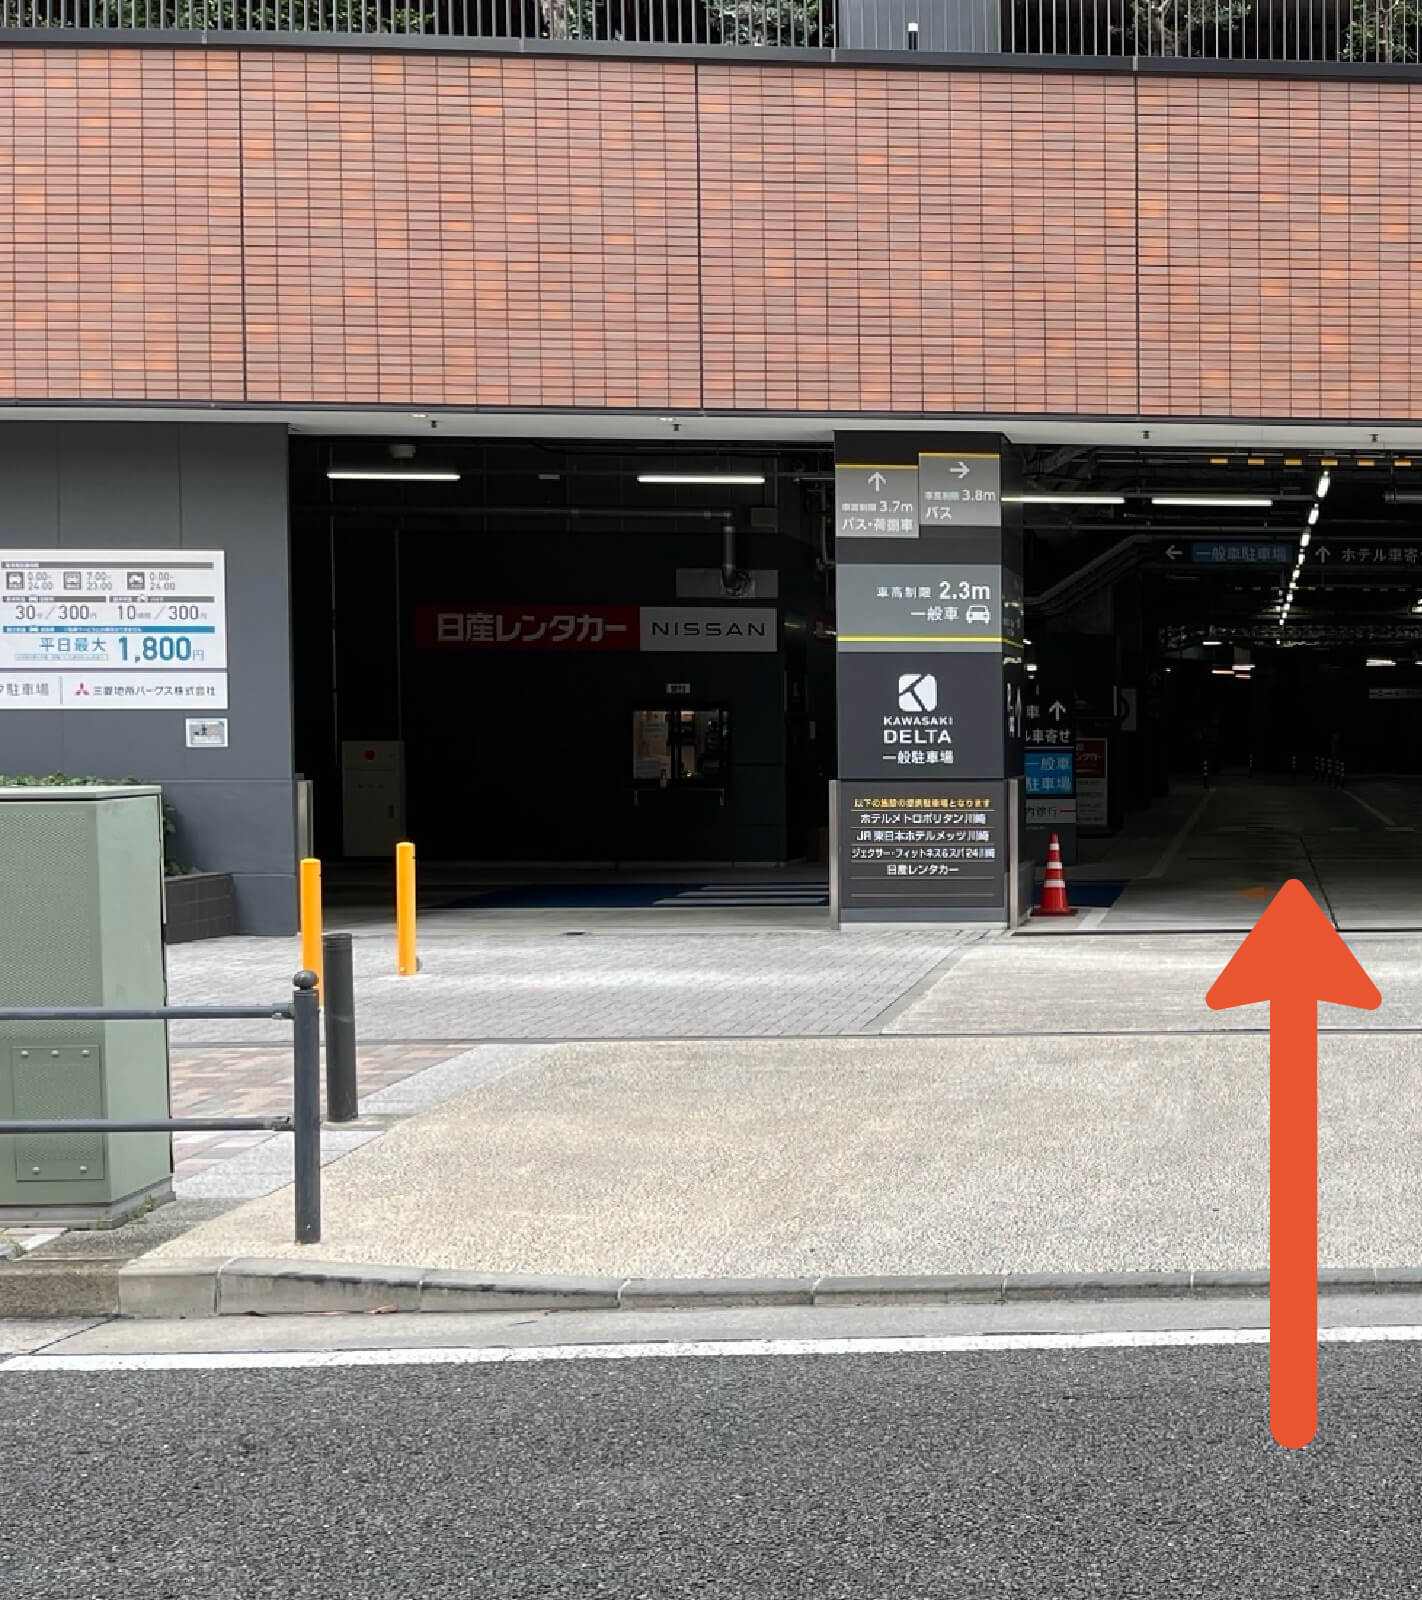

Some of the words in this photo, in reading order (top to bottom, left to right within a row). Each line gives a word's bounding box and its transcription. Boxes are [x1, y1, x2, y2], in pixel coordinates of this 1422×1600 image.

[962, 489, 996, 501] 3.8m
[879, 500, 913, 512] 3.7m
[925, 506, 952, 520] バス
[939, 581, 990, 600] 2.3m
[911, 606, 960, 621] 一般車
[437, 613, 627, 642] 日産レンタカー
[652, 622, 765, 636] NISSAN
[0, 683, 49, 697] 駐車場
[884, 716, 953, 726] KAWASAKI
[884, 730, 951, 744] DELTA
[882, 750, 954, 765] 一般駐車場
[1026, 776, 1072, 793] 駐車場
[860, 814, 987, 825] ホテルメトロポリタン川崎
[887, 865, 960, 876] 日産レンタカー
